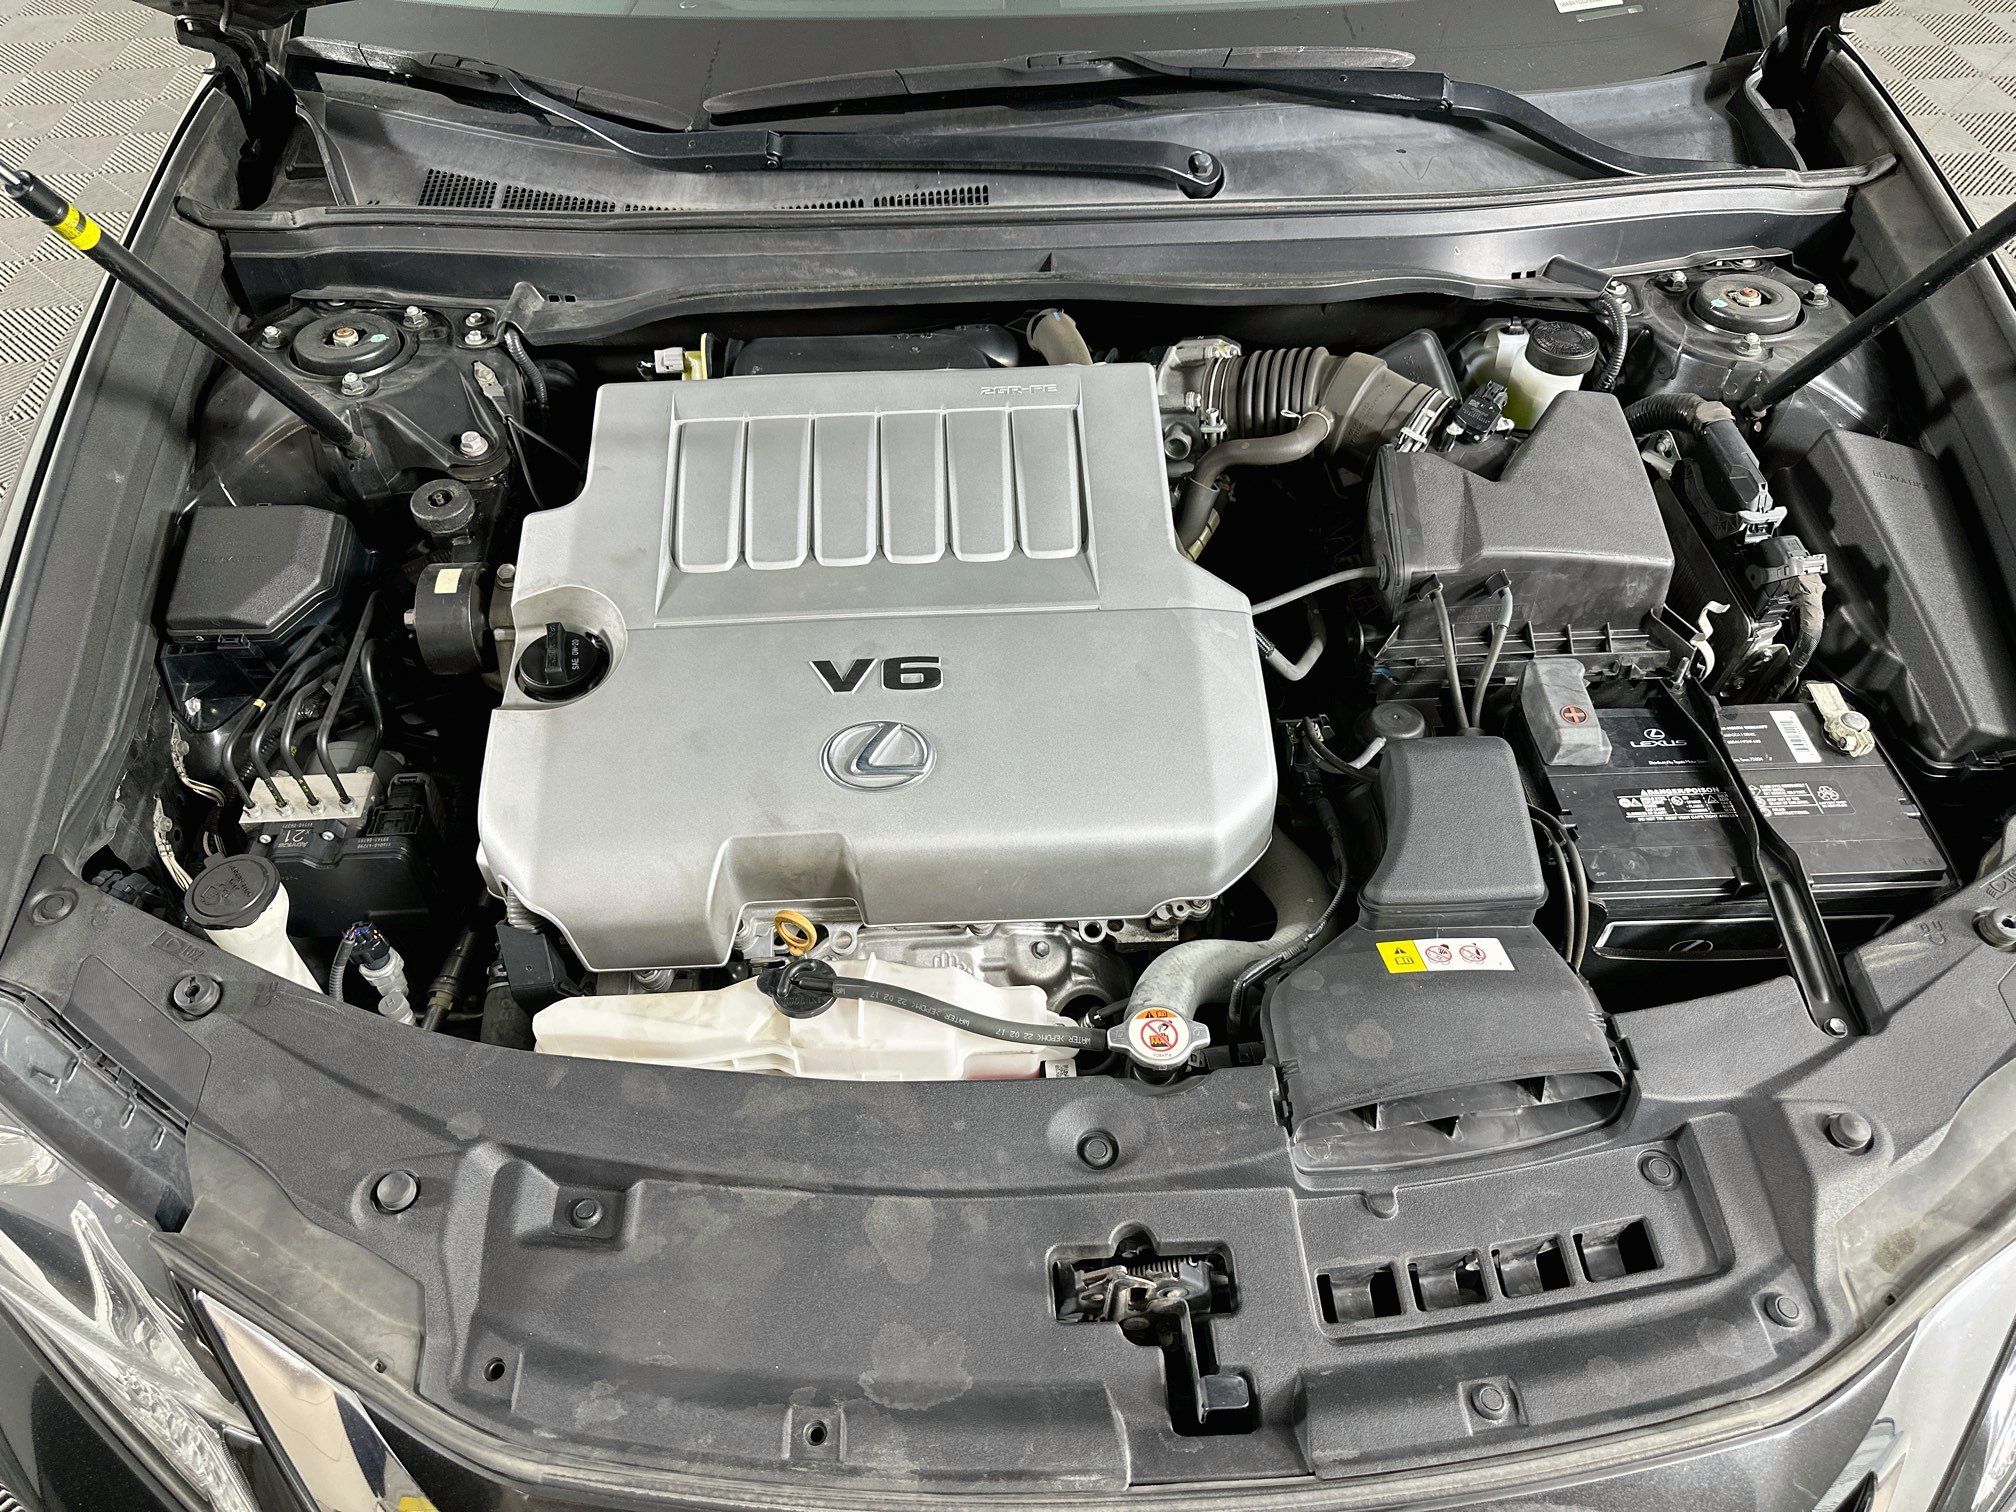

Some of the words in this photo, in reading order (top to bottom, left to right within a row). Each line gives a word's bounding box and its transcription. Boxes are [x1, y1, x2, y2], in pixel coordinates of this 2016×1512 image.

[980, 383, 1058, 396] 2GR-FE
[571, 638, 580, 656] 0W-20
[571, 658, 580, 670] SAE
[808, 655, 944, 695] V6
[1629, 739, 1688, 748] LEXUS
[1648, 787, 1720, 796] DANGER/POISON
[869, 991, 880, 999] 17
[883, 993, 894, 1001] 02
[896, 997, 908, 1006] 22
[943, 1013, 970, 1027] WATER
[995, 1028, 1006, 1036] 17
[1009, 1029, 1020, 1038] 02
[1023, 1032, 1034, 1040] 22
[1068, 1035, 1091, 1045] WATER
